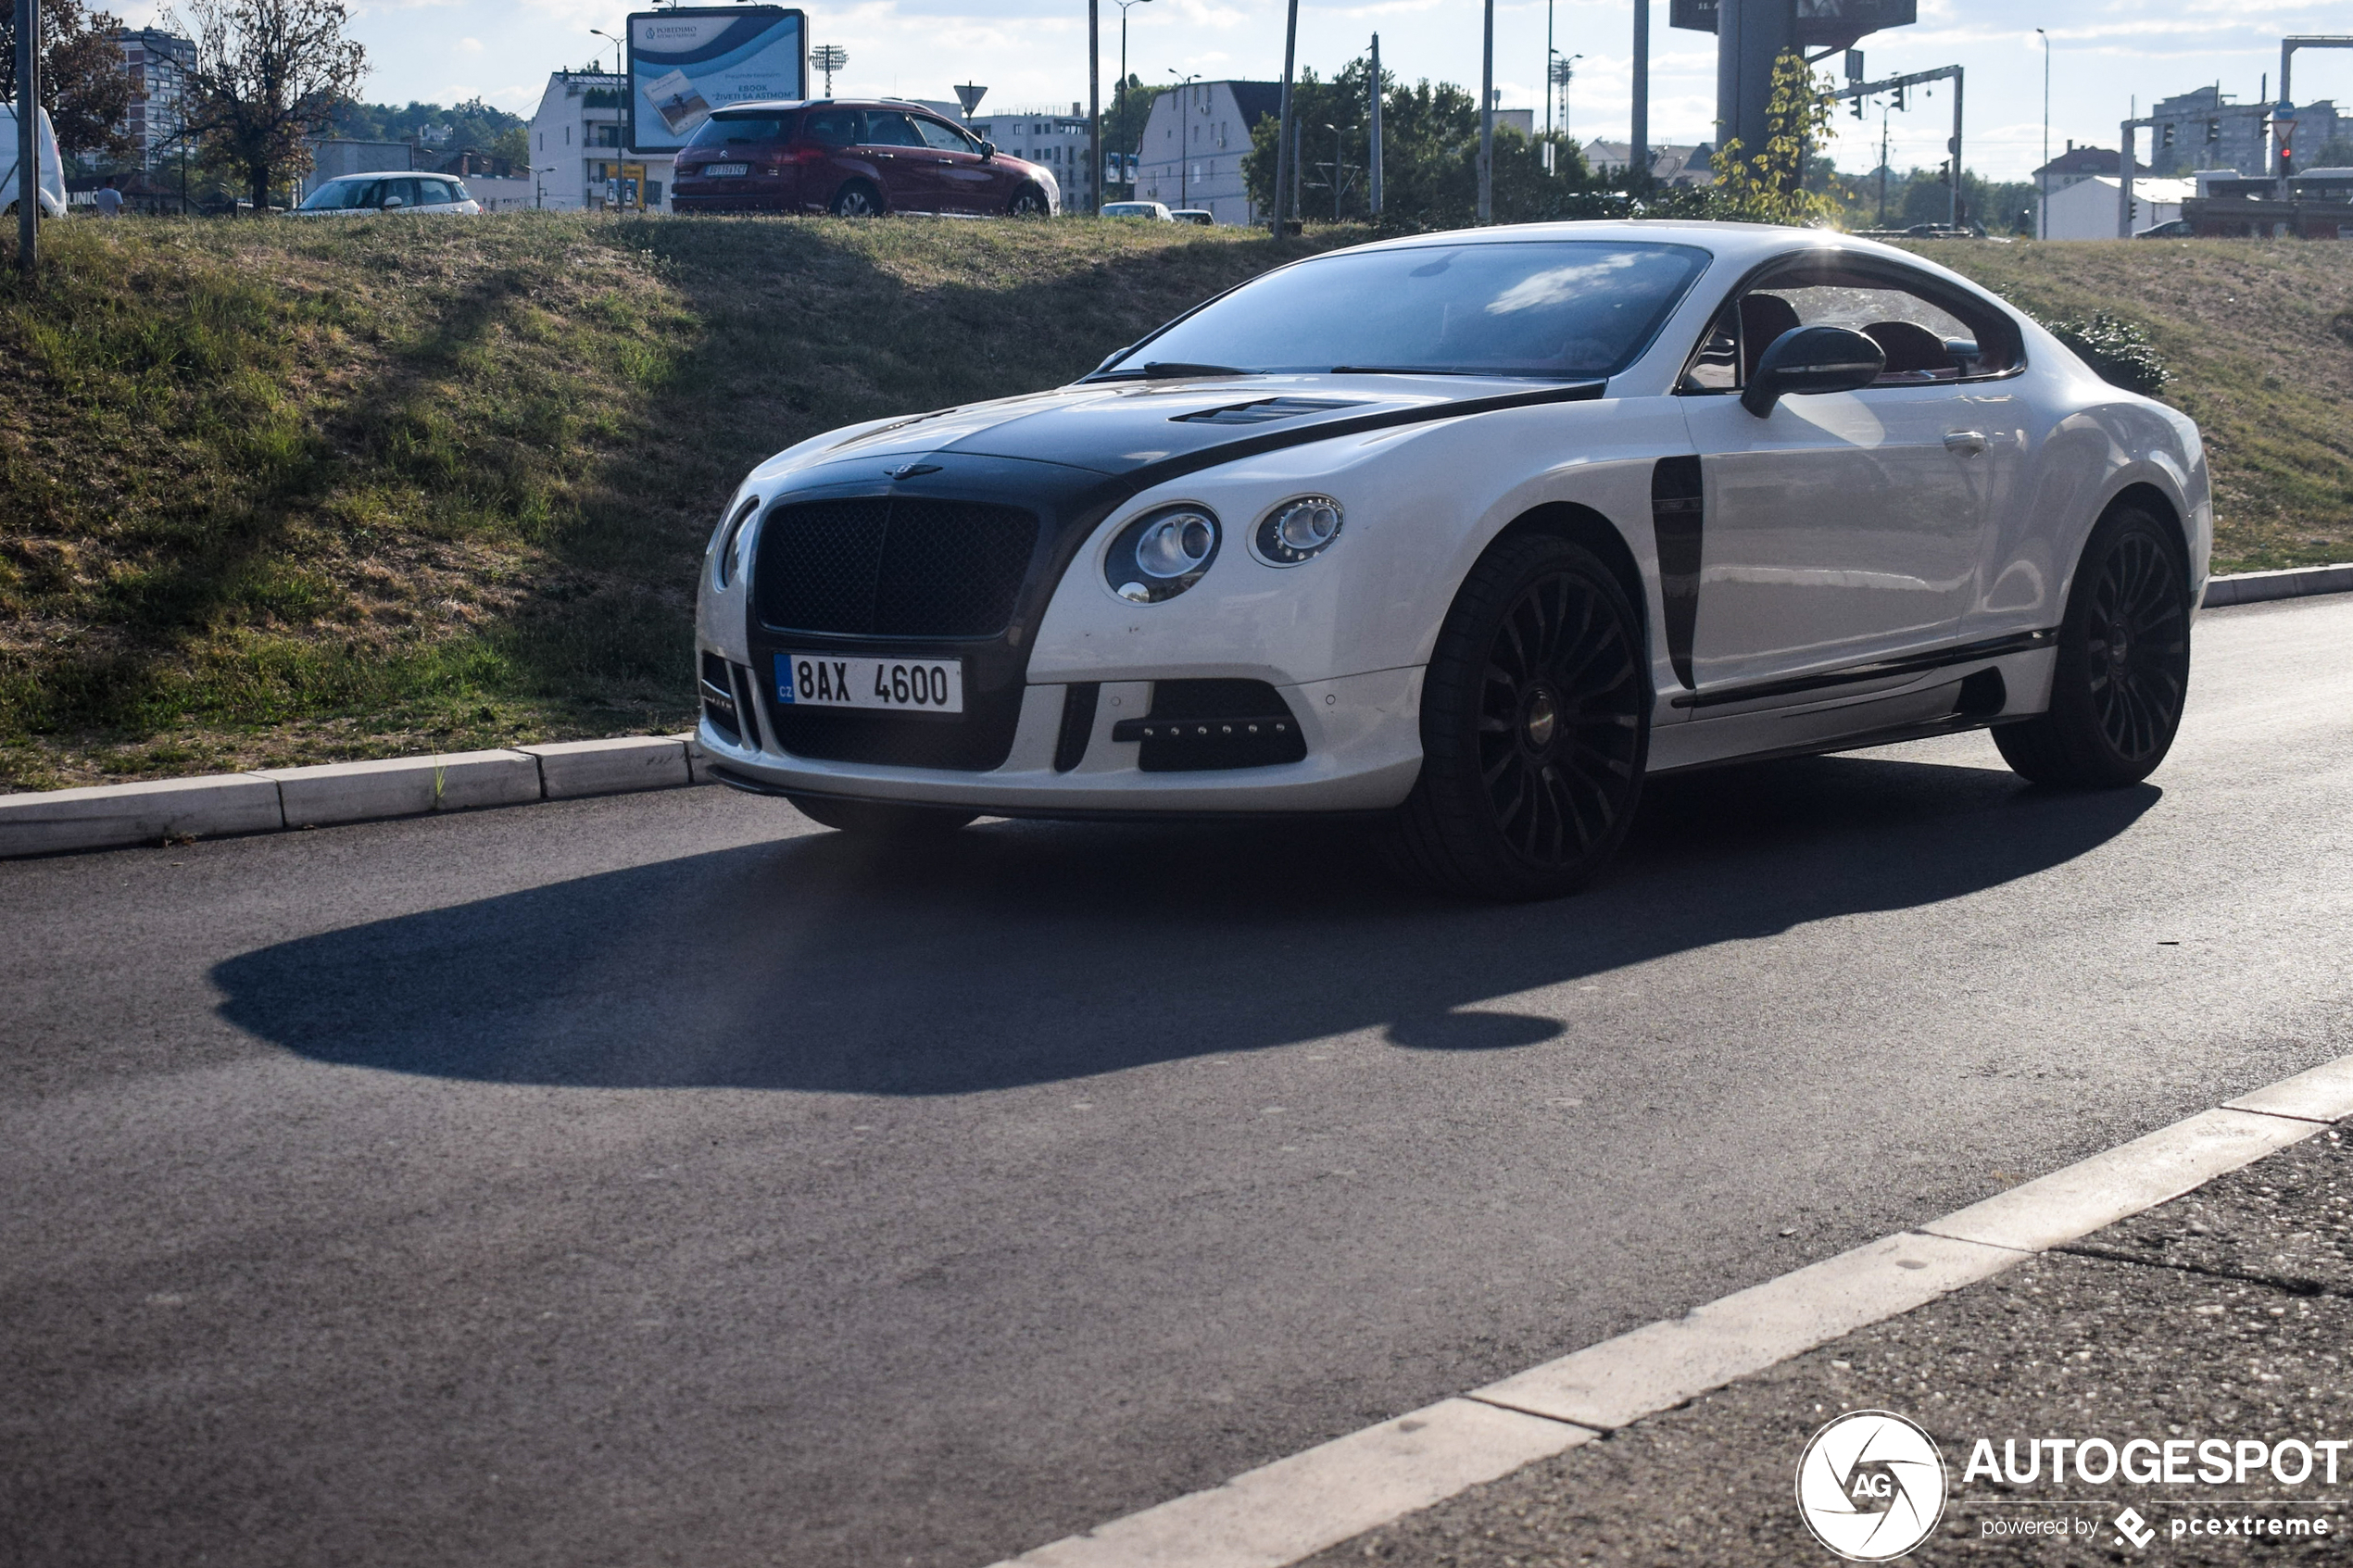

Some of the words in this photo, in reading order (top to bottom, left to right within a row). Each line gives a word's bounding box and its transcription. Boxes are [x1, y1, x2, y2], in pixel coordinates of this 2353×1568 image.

[779, 686, 792, 697] CZ
[798, 660, 850, 701] 8AX
[875, 664, 948, 706] 4600
